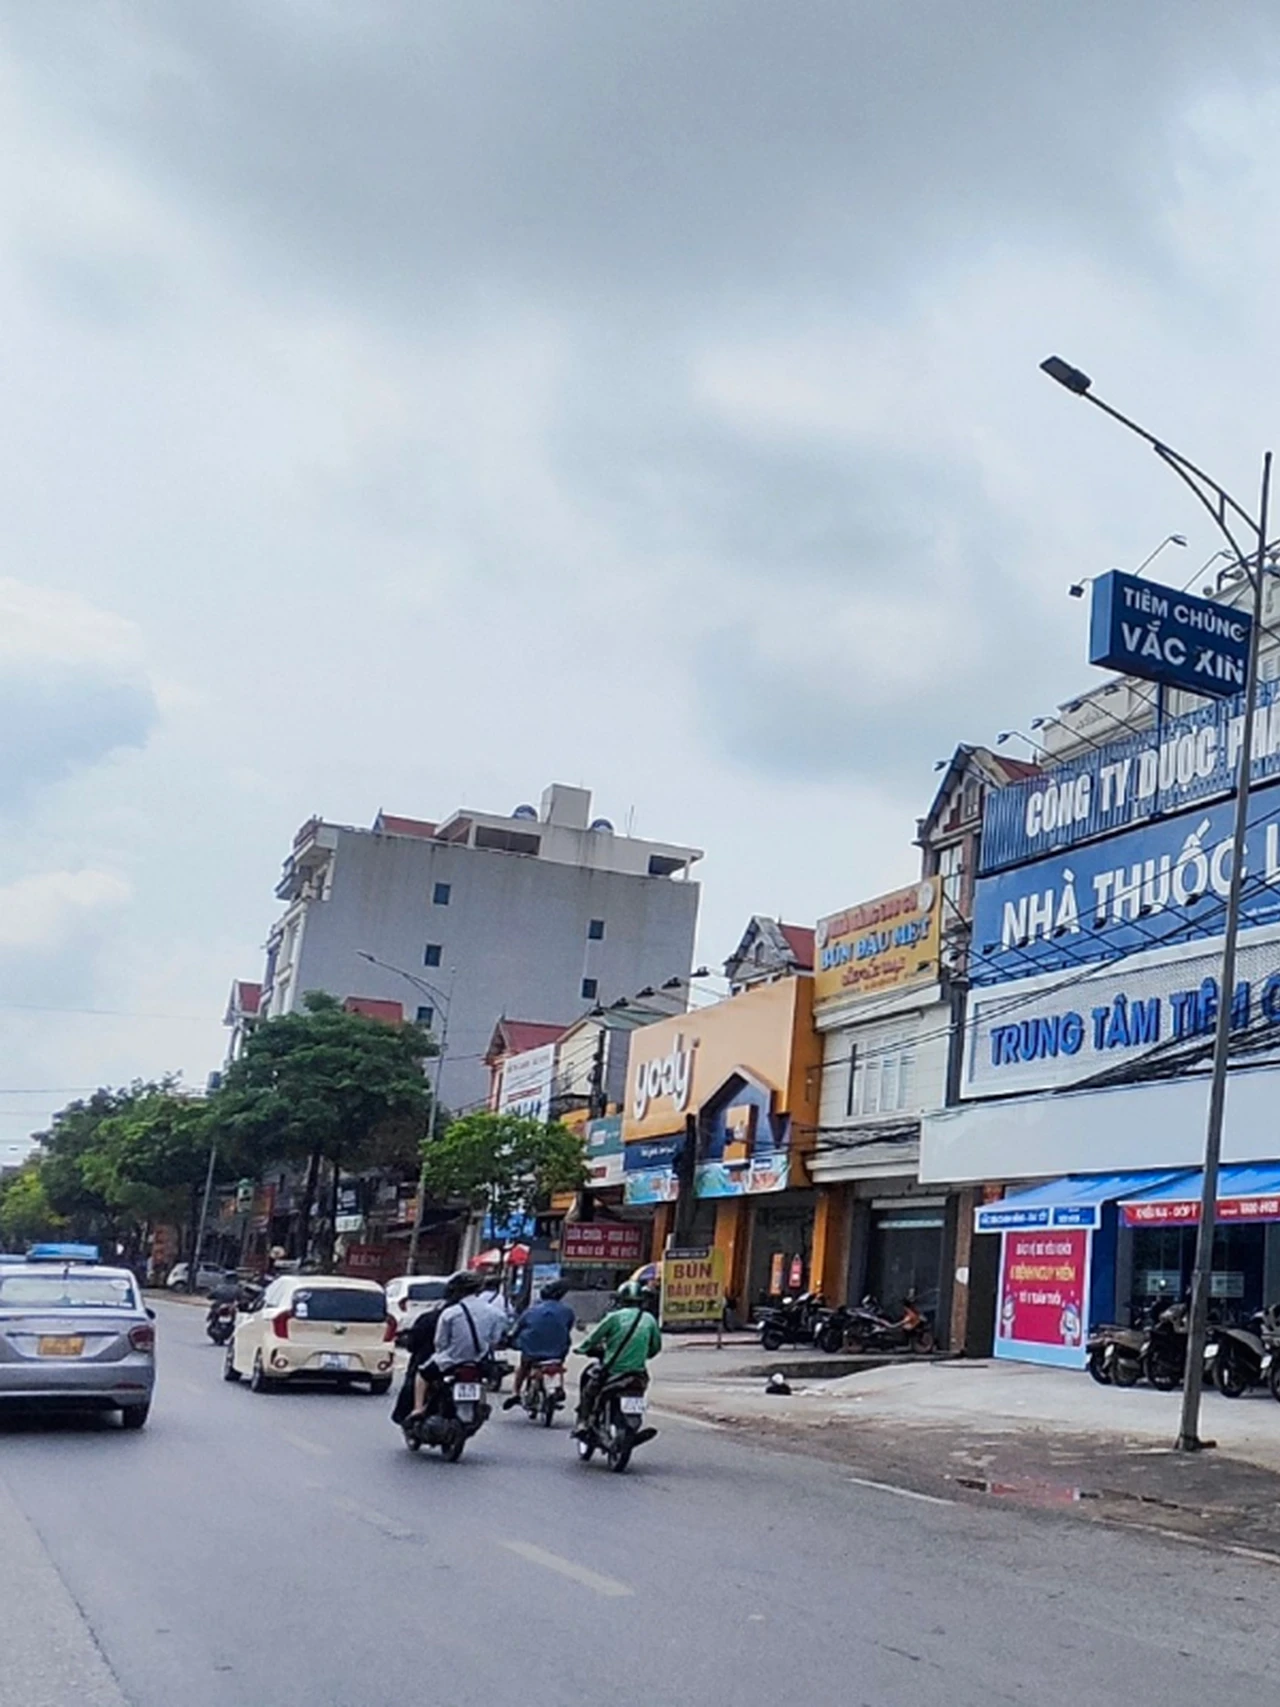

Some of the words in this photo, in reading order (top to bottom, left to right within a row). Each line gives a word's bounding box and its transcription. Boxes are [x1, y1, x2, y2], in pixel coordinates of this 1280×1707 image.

[1123, 587, 1168, 618] TIÊM
[1121, 620, 1187, 665] VẮC
[1025, 773, 1092, 838] CÔNG
[1100, 758, 1133, 812] TY
[1001, 868, 1081, 951] NHÀ
[1093, 818, 1248, 924] THUỐC
[989, 1011, 1085, 1066] TRUNG
[1092, 993, 1161, 1050] TÂM
[633, 1033, 694, 1121] yody
[673, 1260, 713, 1279] BÚN
